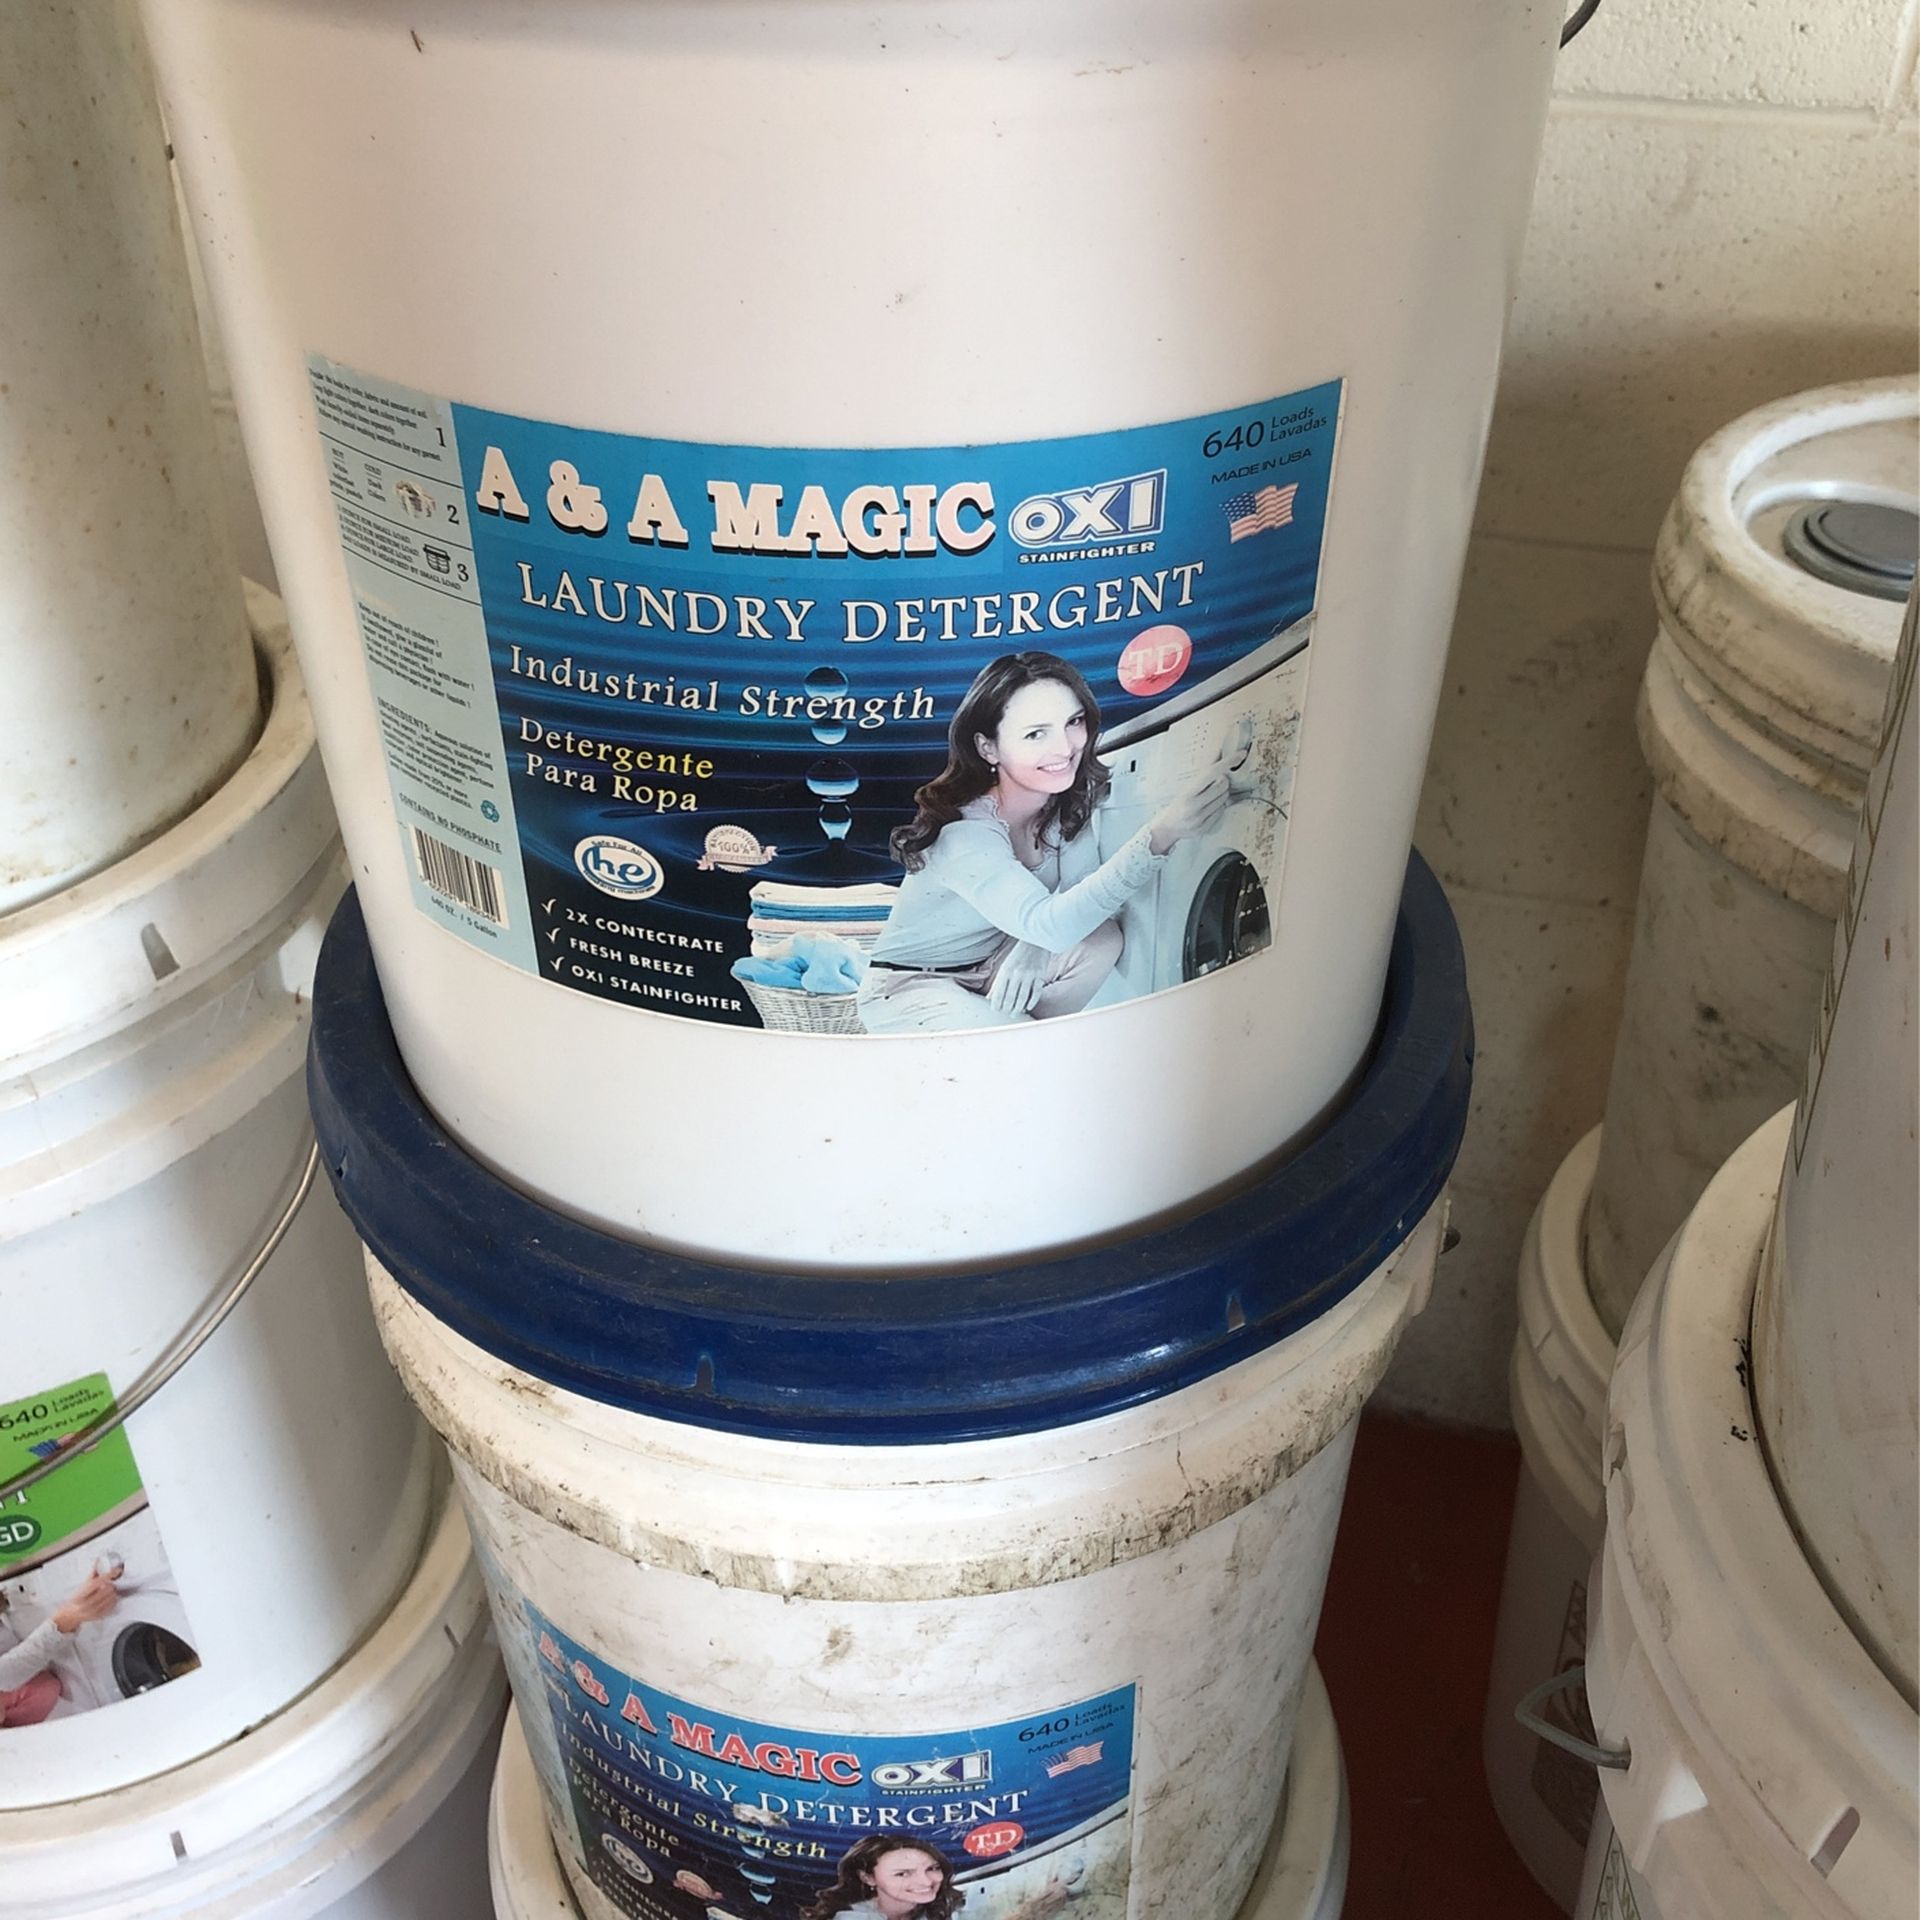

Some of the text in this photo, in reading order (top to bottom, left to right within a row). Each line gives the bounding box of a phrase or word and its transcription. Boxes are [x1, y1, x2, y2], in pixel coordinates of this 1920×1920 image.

[1270, 416, 1327, 442] Lavadas
[1272, 406, 1314, 428] Loads
[436, 427, 446, 447] 1
[1203, 421, 1264, 458] 640
[1211, 448, 1312, 484] MADE IN USA
[447, 505, 459, 524] 2
[476, 446, 996, 556] A & A MAGIC
[1010, 472, 1163, 547] OXI
[1018, 541, 1156, 564] STAINFIGHTER
[457, 563, 469, 582] 3
[517, 561, 1205, 644] LAUNDRY DETERGENT
[1129, 641, 1184, 680] TD
[509, 644, 936, 730] Industrial Strength
[519, 716, 715, 780] Detergente
[525, 753, 699, 814] Para Ropa
[591, 846, 645, 881] he
[718, 842, 750, 854] 100%
[565, 908, 724, 953] 2X CONTECTRATE
[569, 937, 695, 977] FRESH BREEZE
[571, 964, 742, 1012] OXI STAINFIGHTER
[620, 1692, 658, 1737] A
[667, 1712, 862, 1786] MAGIC
[1018, 1717, 1070, 1742] 640
[561, 1688, 1029, 1828] LAUNDRY DETERGENT
[872, 1752, 990, 1788] OXI
[562, 1722, 827, 1858] Industrial Strength
[881, 1784, 986, 1796] STAINFIGHTER
